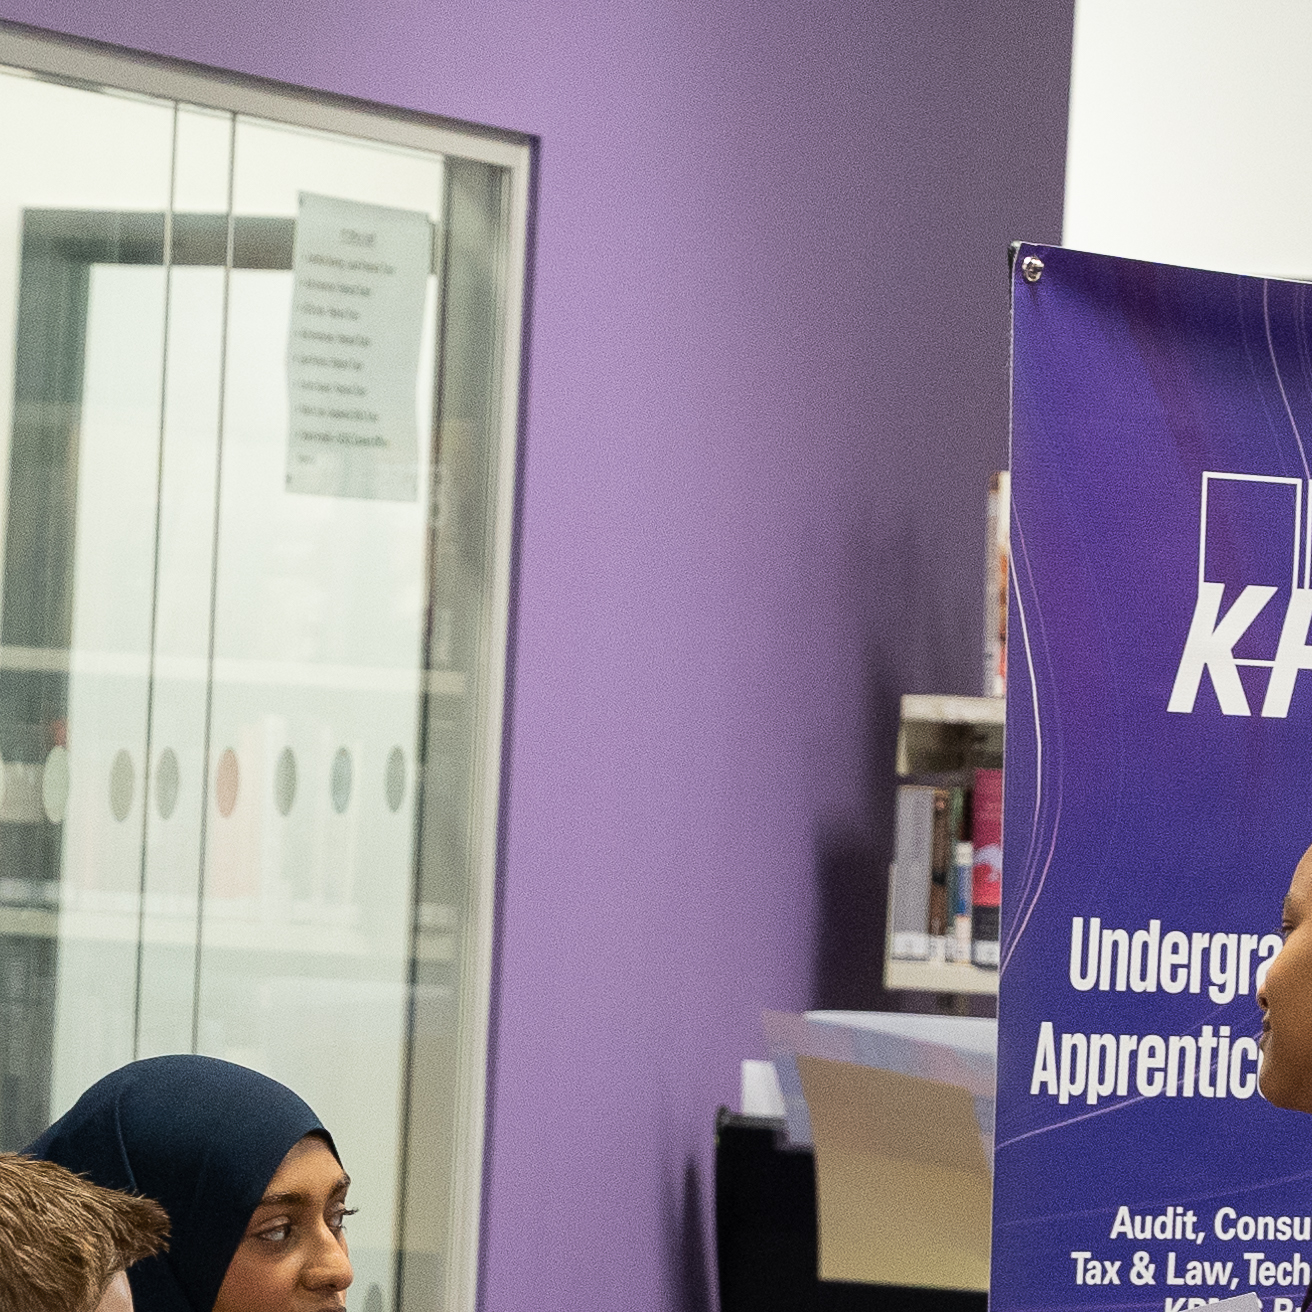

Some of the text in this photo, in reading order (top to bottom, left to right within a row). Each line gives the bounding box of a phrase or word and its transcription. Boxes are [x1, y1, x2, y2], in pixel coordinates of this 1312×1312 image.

[1030, 1022, 1266, 1105] Apprentic
[1110, 1206, 1206, 1244] Audit,
[1071, 1251, 1121, 1285] Tax
[1130, 1251, 1156, 1286] &
[1166, 1252, 1239, 1290] Law,
